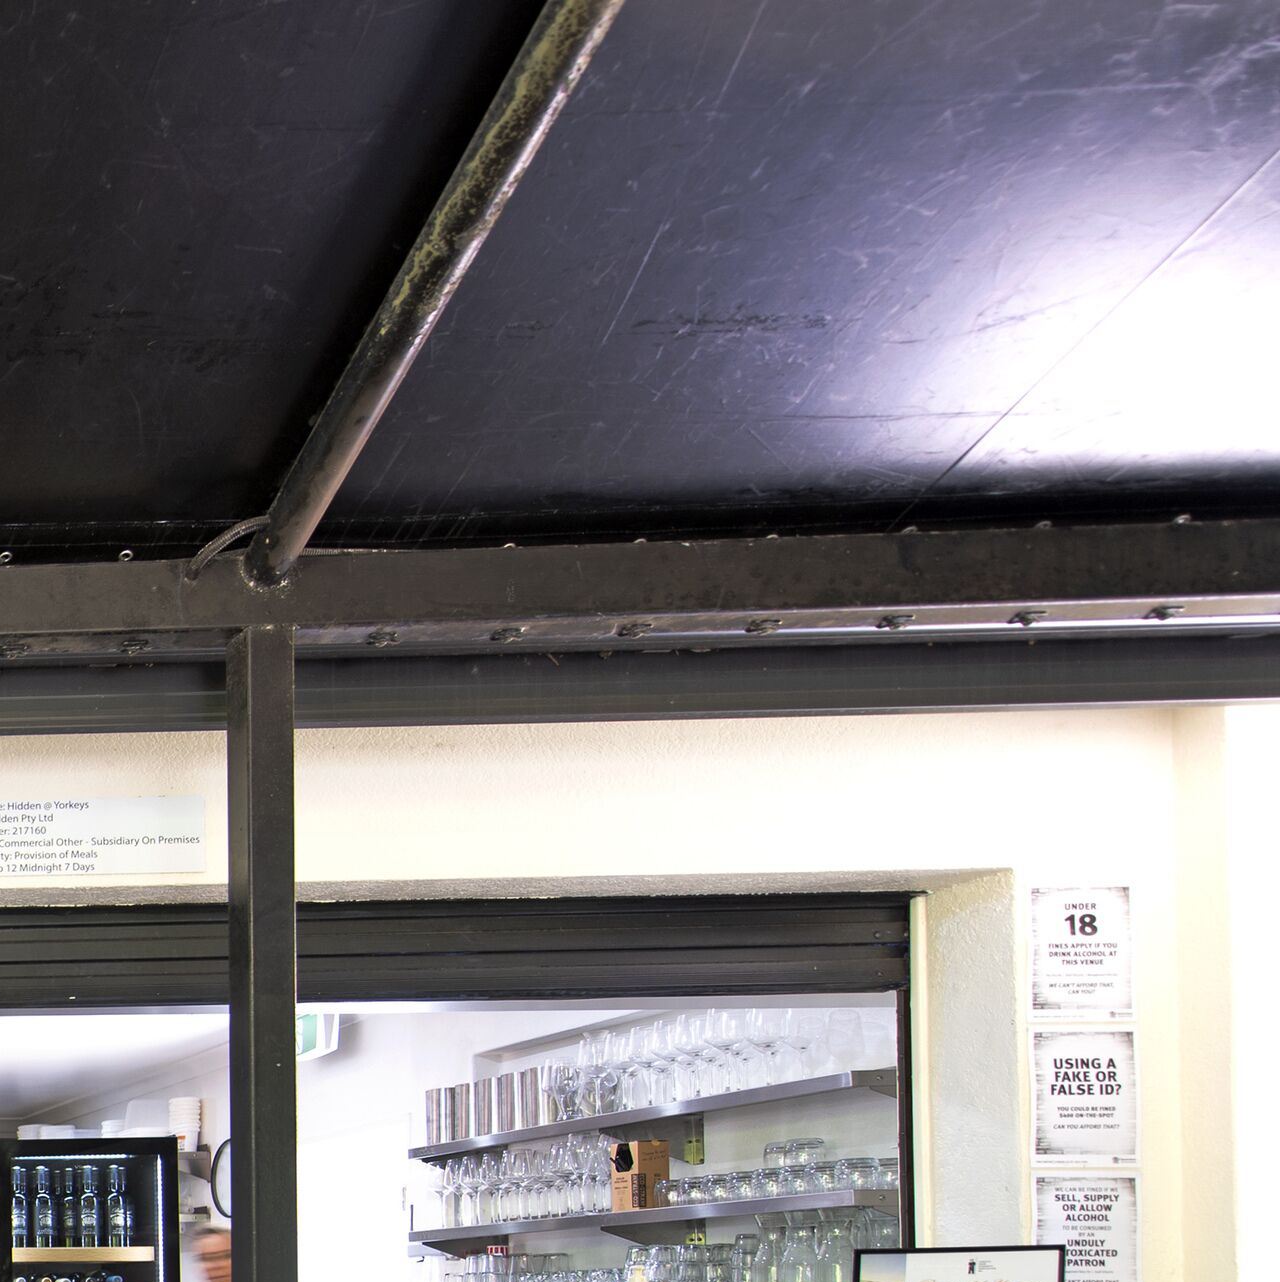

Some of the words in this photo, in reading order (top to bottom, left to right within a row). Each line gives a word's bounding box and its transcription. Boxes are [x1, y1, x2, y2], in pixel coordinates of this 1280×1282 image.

[7, 802, 41, 810] Hidden
[43, 802, 52, 811] @
[53, 801, 89, 811] Yorkeys
[21, 814, 36, 824] Pty
[38, 813, 54, 822] Ltd
[12, 826, 47, 835] 217160
[55, 838, 83, 846] Other
[91, 837, 140, 846] Subsidiary
[142, 836, 156, 845] On
[158, 835, 200, 844] Premises
[14, 851, 56, 860] Provision
[59, 850, 68, 859] of
[70, 850, 98, 859] Meals
[6, 864, 17, 872] 12
[19, 863, 61, 874] Midnight
[64, 863, 70, 871] 7
[72, 862, 95, 872] Days
[1064, 914, 1098, 936] 18
[1053, 1058, 1102, 1070] USING
[1106, 1058, 1117, 1069] A
[1054, 1071, 1091, 1082] FAKE
[1095, 1071, 1117, 1082] OR
[1050, 1084, 1095, 1095] FALSE
[1100, 1084, 1122, 1095] ID?
[1054, 1194, 1081, 1202] SELL,
[1083, 1194, 1120, 1202] SUPPLY
[1062, 1204, 1076, 1212] OR
[1079, 1204, 1112, 1212] ALLOW
[1065, 1213, 1110, 1222] ALCOHOL
[1067, 1239, 1106, 1247] UNDULY
[1066, 1249, 1118, 1257] TOXICATED
[1067, 1259, 1106, 1267] PATRON
